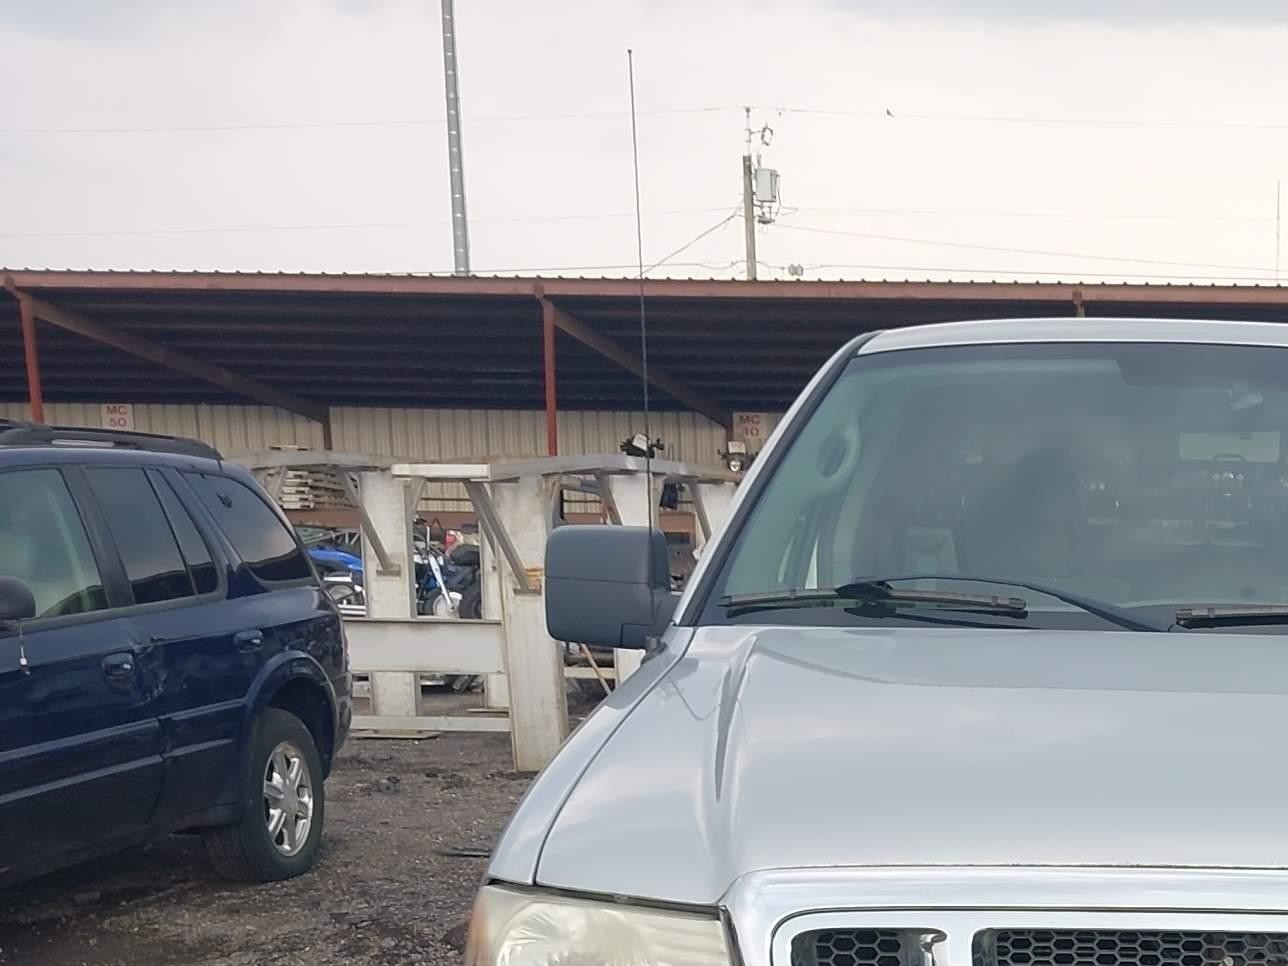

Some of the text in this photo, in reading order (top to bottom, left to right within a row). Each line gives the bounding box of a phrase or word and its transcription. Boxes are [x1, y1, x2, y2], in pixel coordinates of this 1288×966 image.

[106, 404, 128, 416] MC
[110, 416, 127, 428] 50
[739, 414, 761, 425] MC
